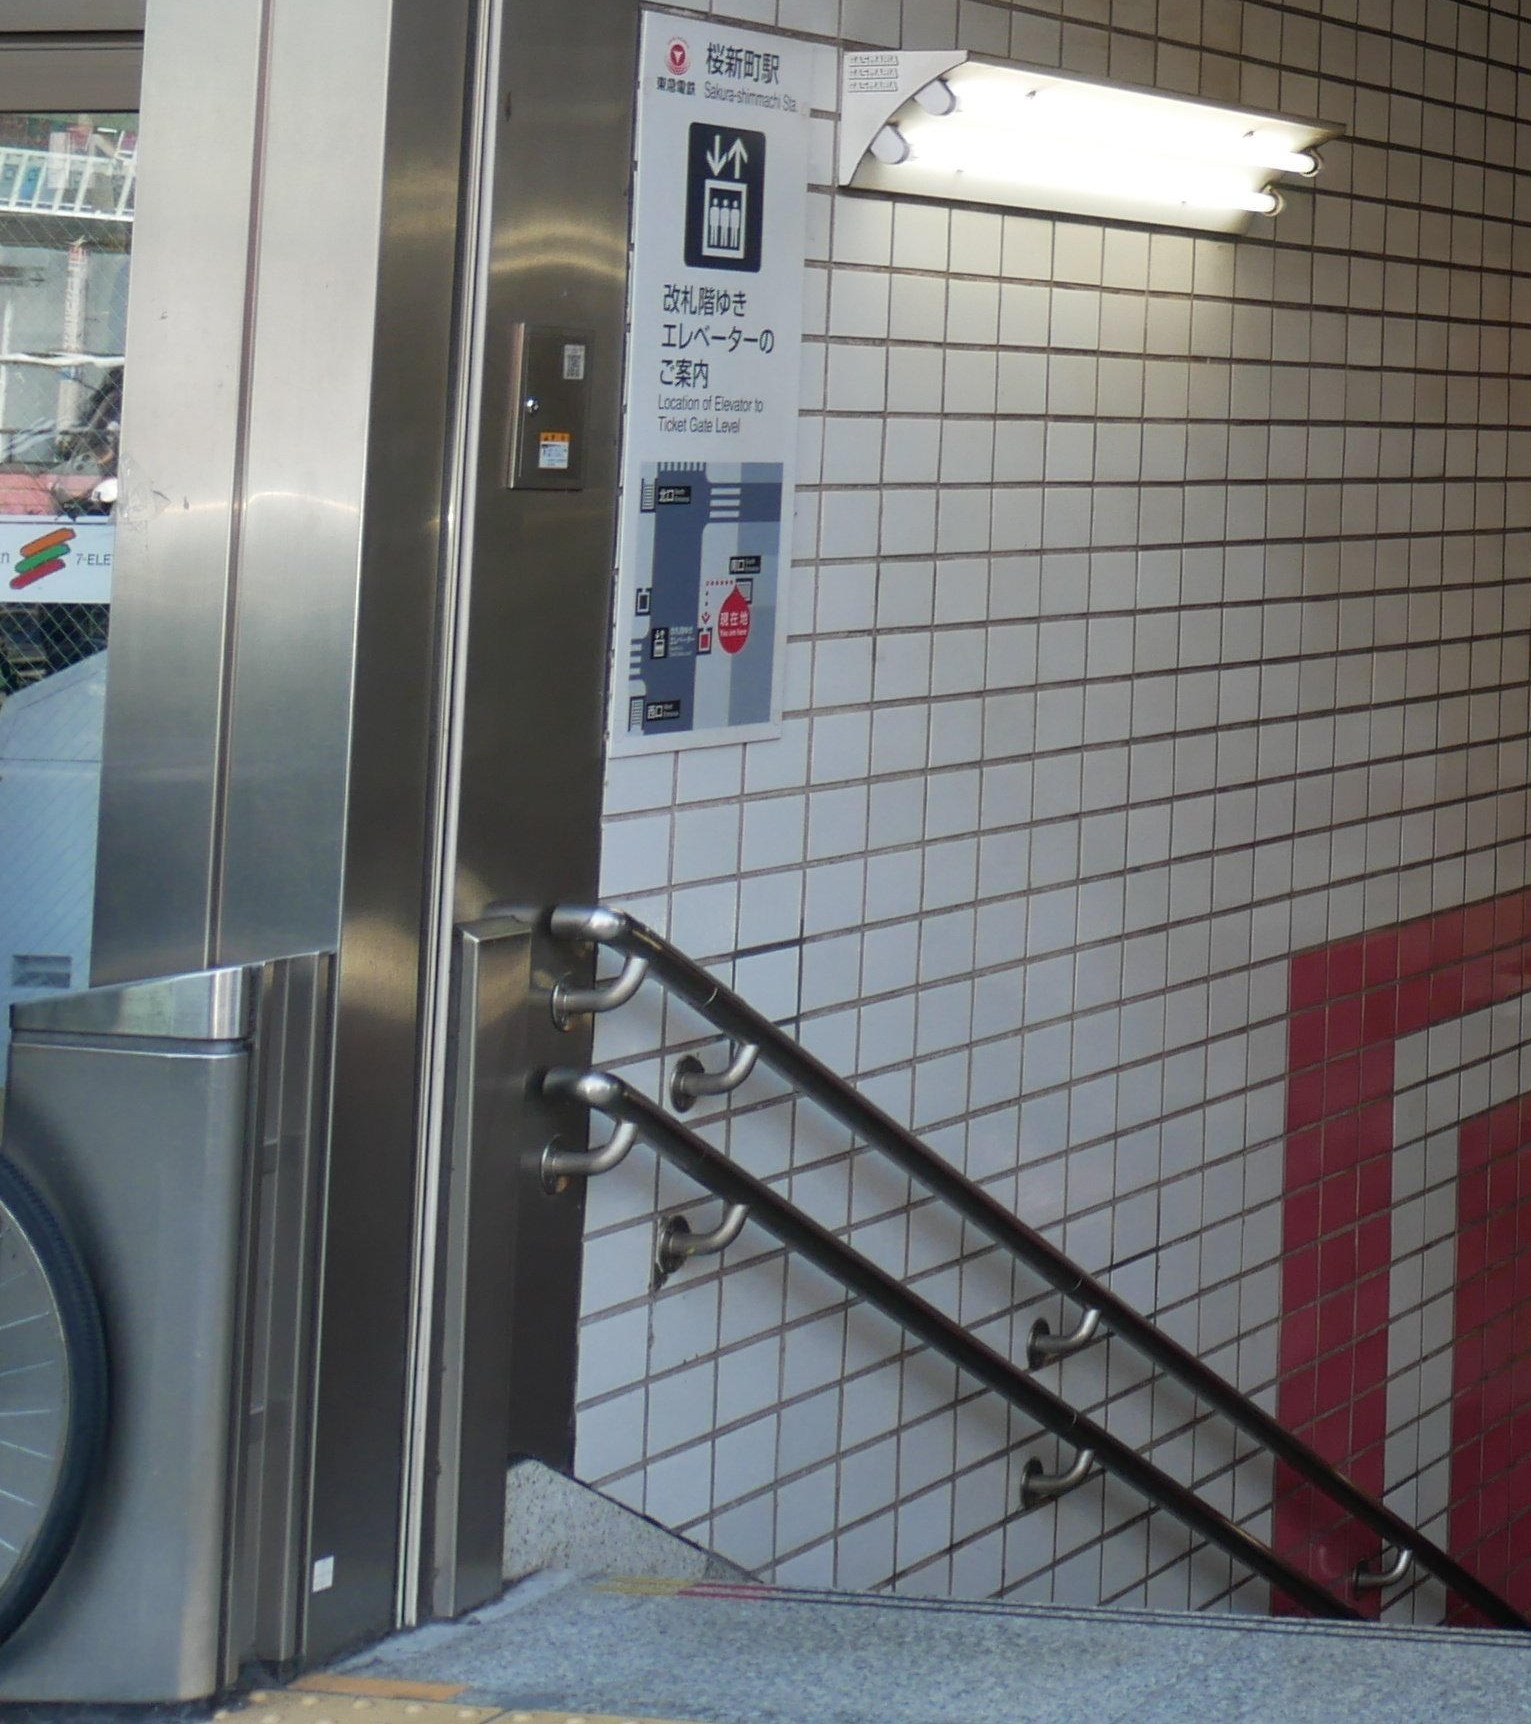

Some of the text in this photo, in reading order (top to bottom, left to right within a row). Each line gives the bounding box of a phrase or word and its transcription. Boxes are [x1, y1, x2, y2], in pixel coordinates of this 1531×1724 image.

[705, 41, 780, 85] 桜新町駅
[663, 284, 747, 317] 改札階ゆき
[661, 323, 775, 354] エレベーターの
[660, 358, 709, 389] ご案内
[658, 393, 764, 413] Location of Elevator to
[658, 415, 741, 434] Ticket Gate Level
[720, 611, 749, 626] 現在地
